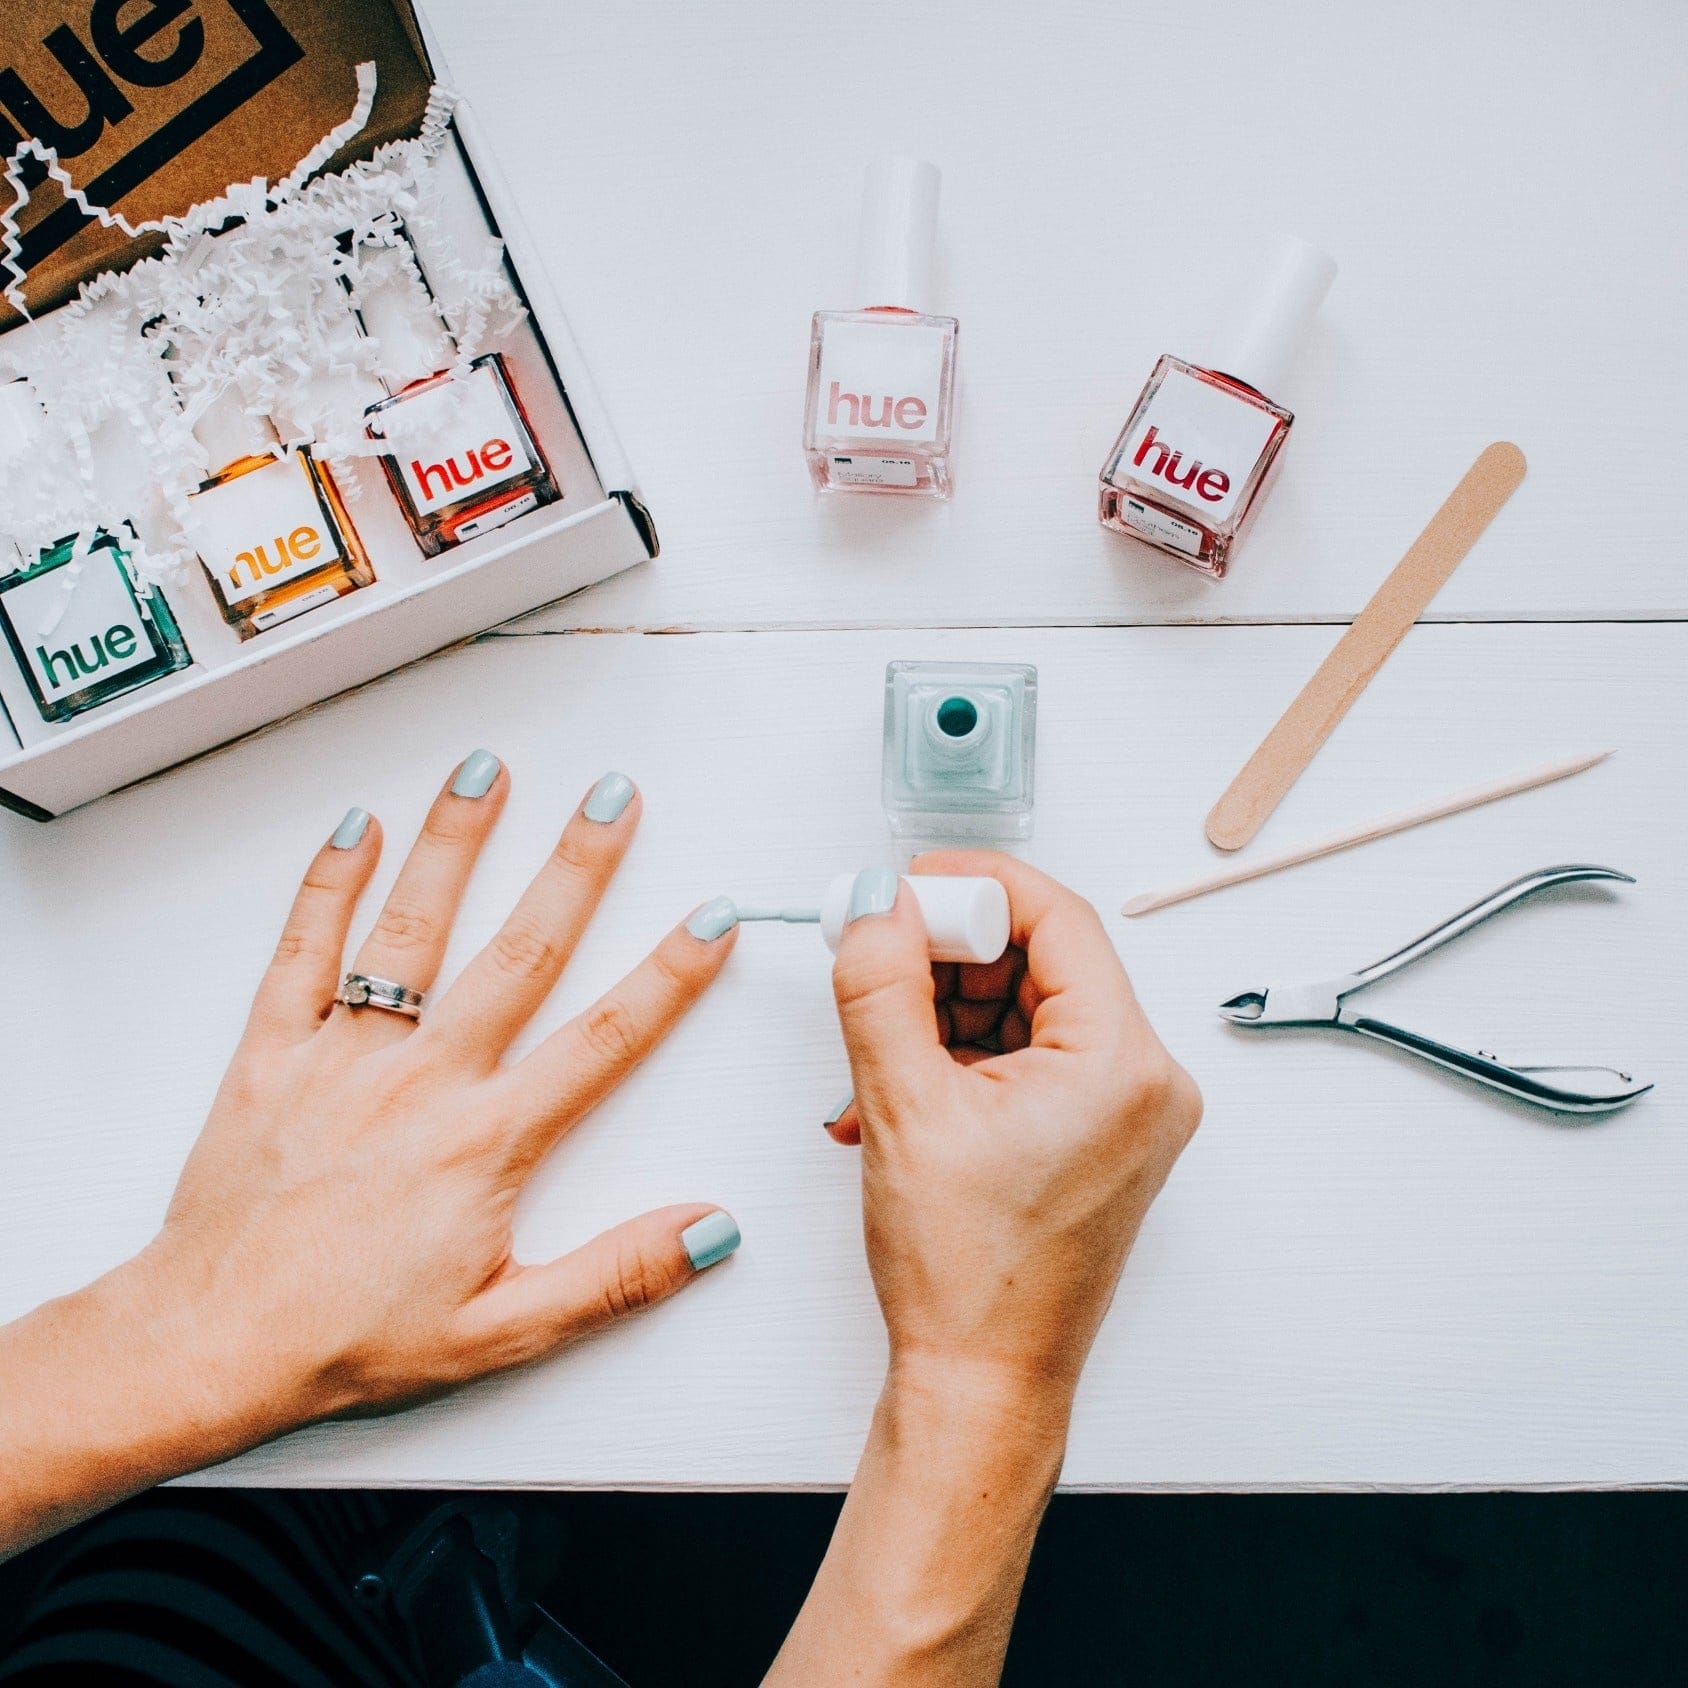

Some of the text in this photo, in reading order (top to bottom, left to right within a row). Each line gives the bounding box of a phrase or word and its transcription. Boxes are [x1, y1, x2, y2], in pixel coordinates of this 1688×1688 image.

[0, 0, 205, 191] ue
[827, 381, 927, 430] hue
[411, 438, 513, 501] hue
[1133, 425, 1231, 503] hue
[36, 624, 137, 689] hue
